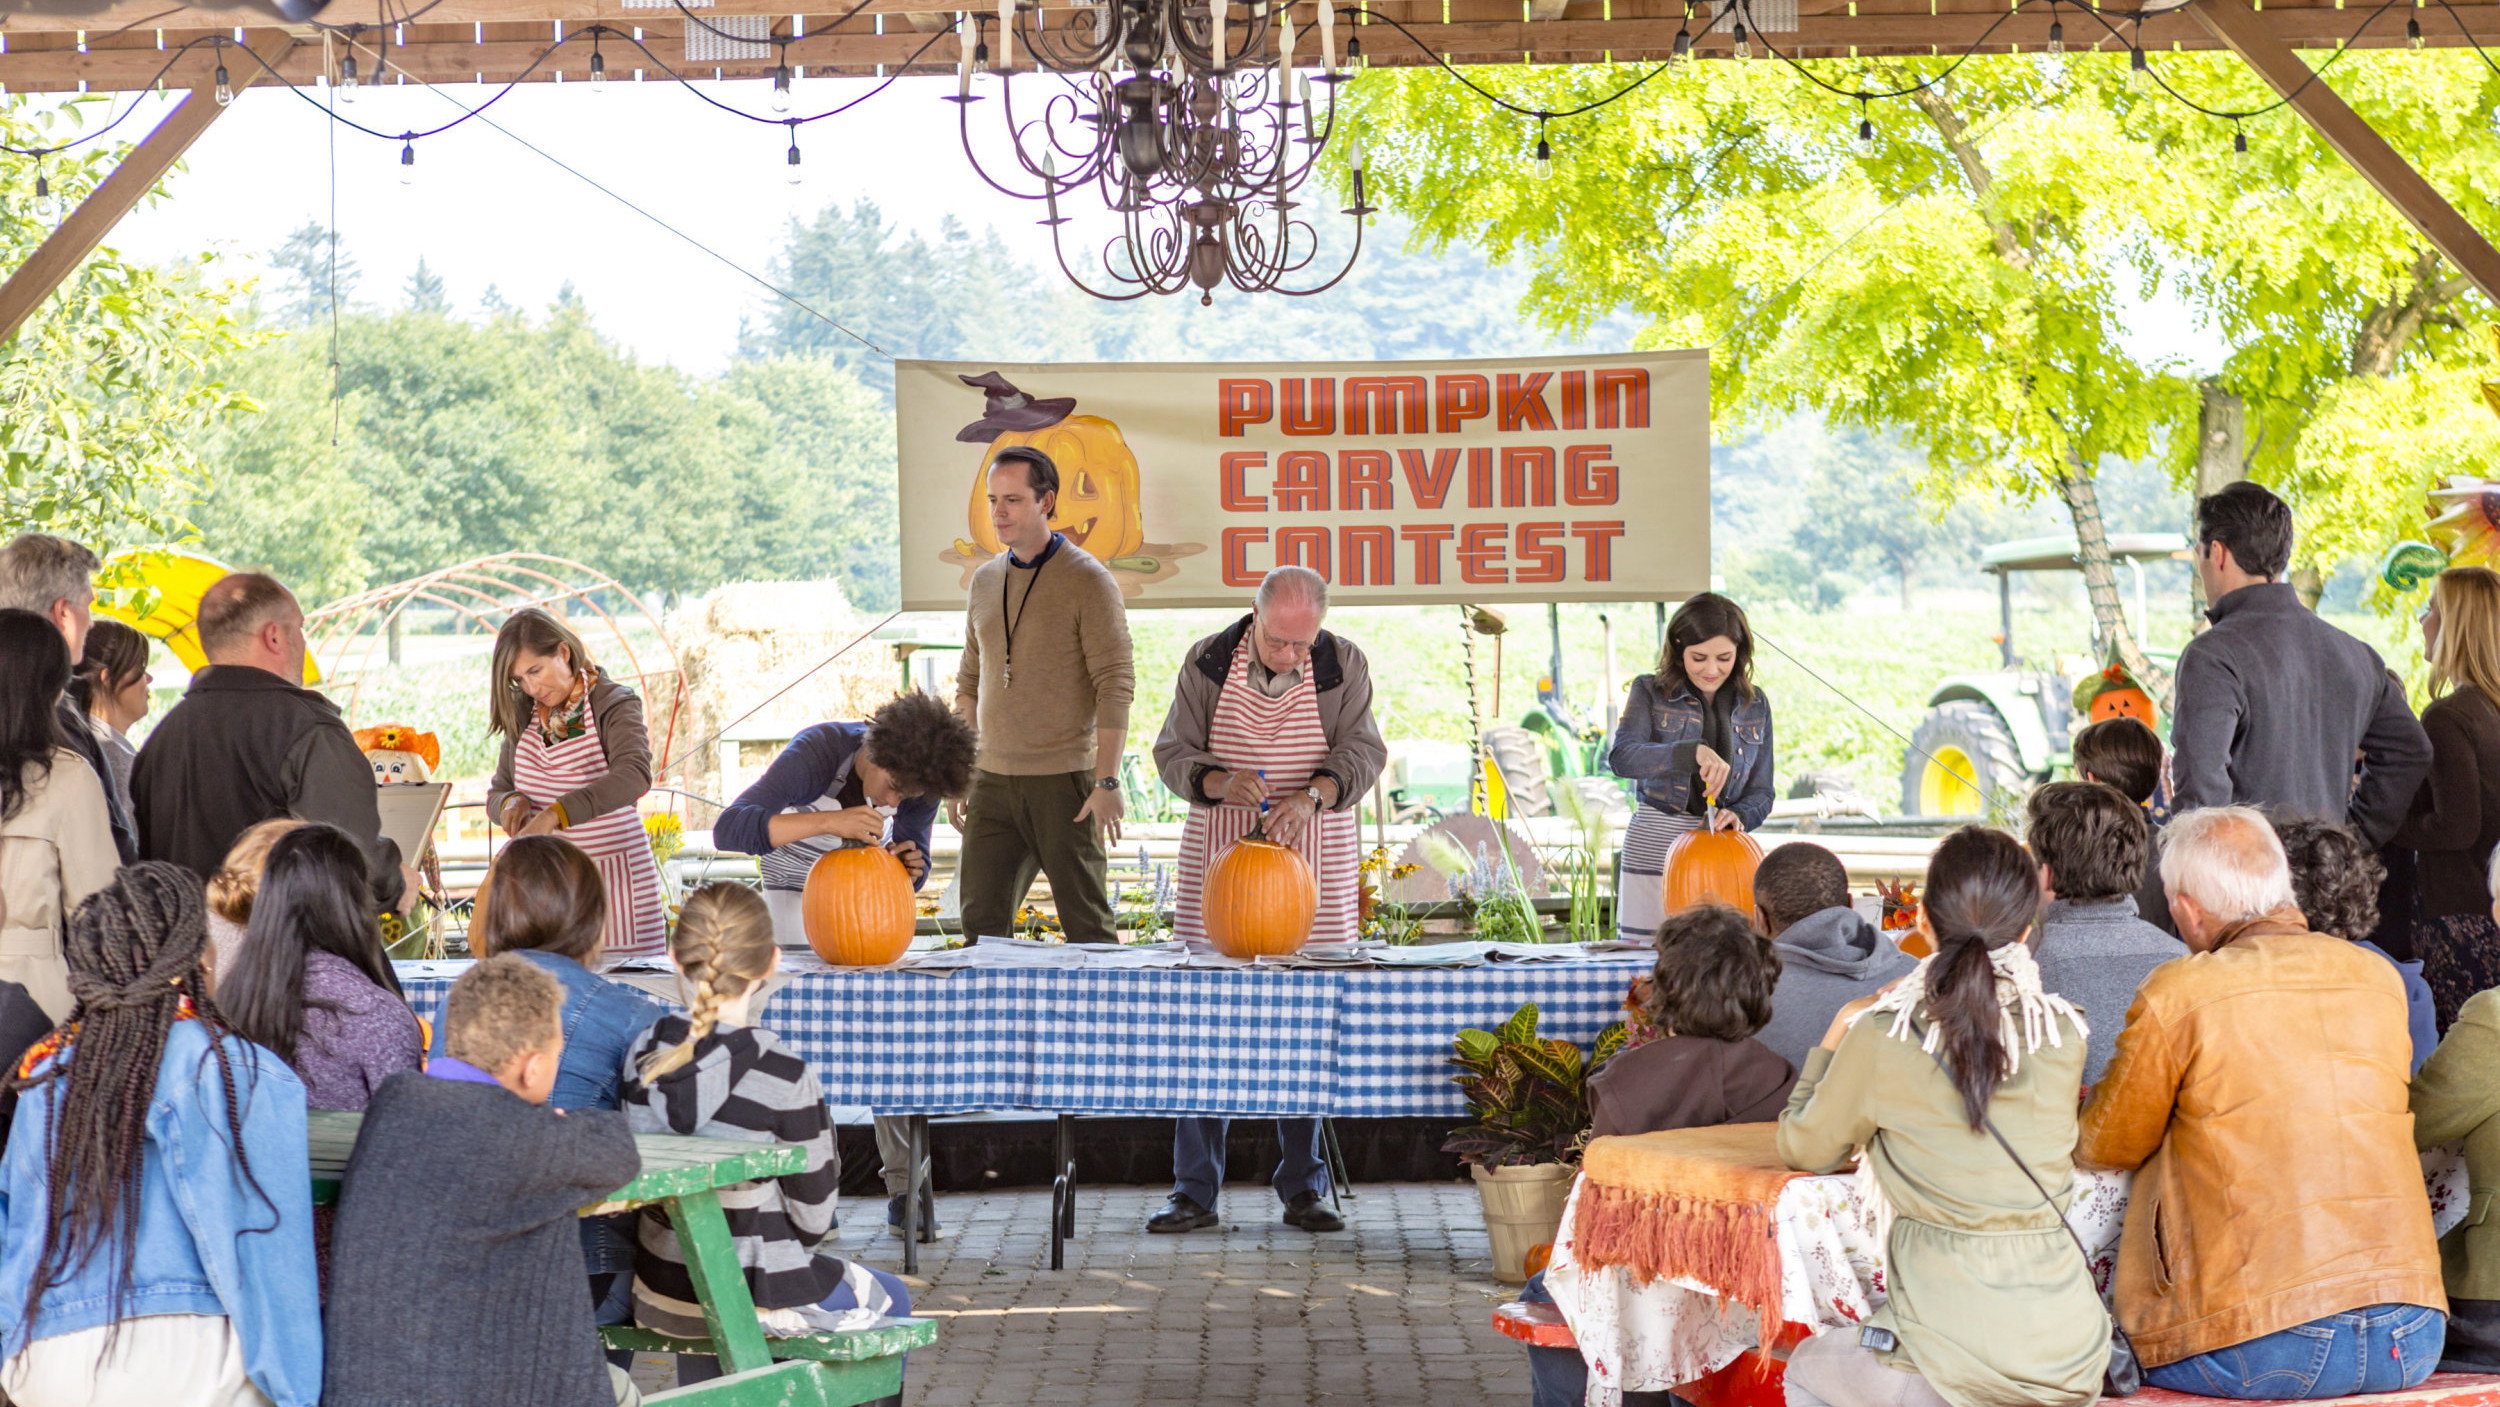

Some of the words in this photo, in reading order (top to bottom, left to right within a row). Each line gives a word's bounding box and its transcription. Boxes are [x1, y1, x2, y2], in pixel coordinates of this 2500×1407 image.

[1218, 367, 1651, 437] PUMPKIN
[1219, 444, 1619, 513] CARVING
[1221, 520, 1626, 588] CONTEST
